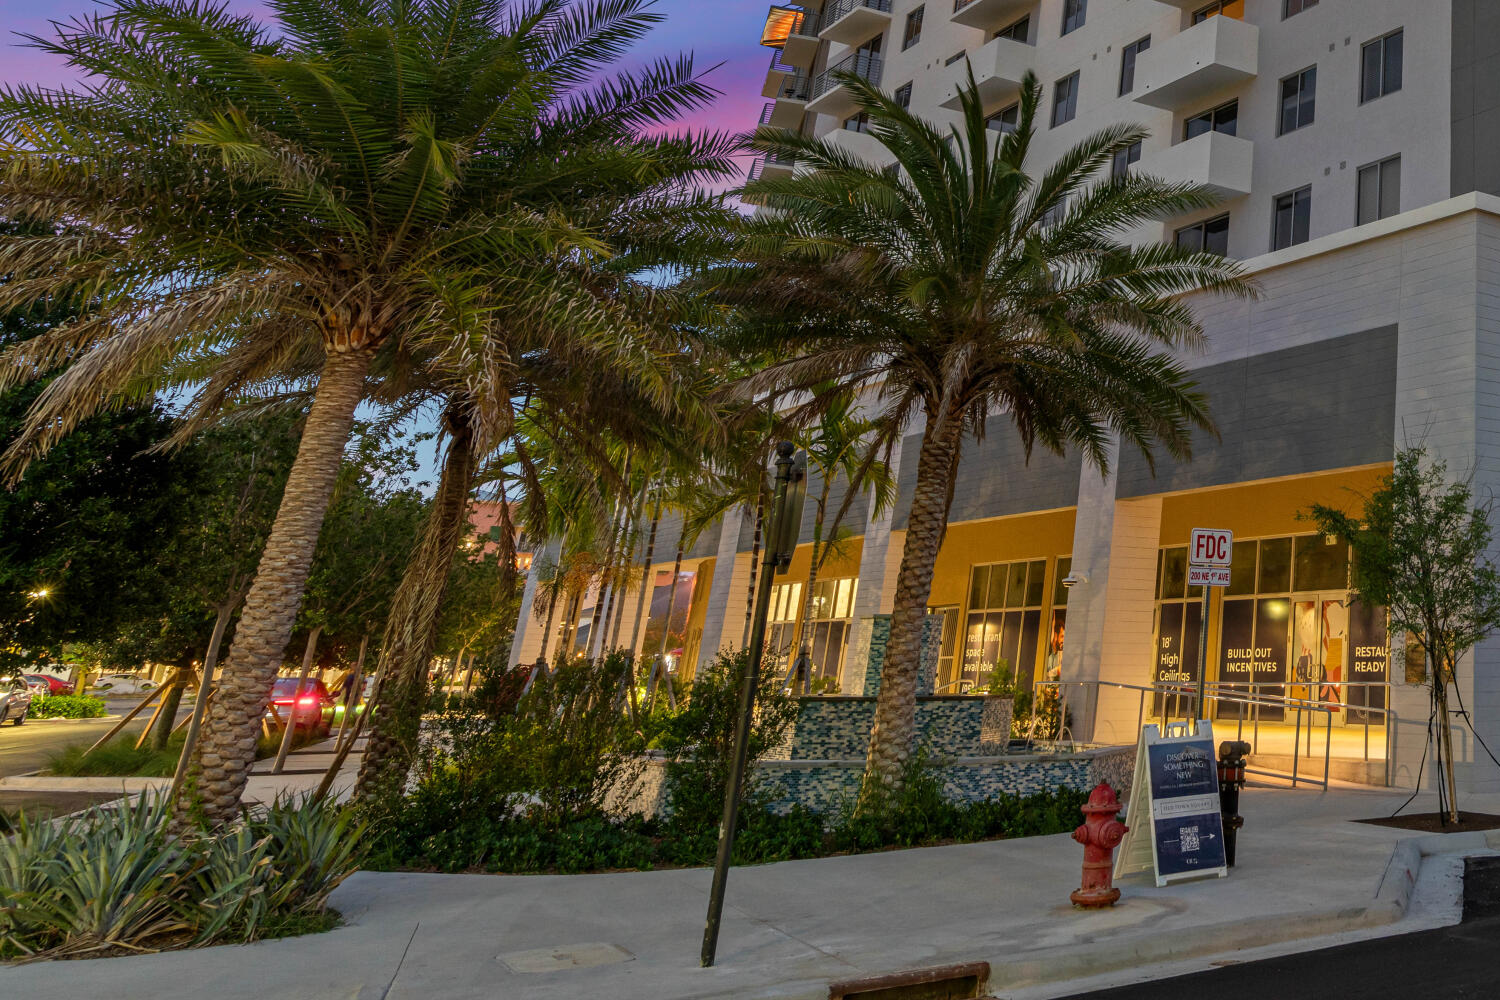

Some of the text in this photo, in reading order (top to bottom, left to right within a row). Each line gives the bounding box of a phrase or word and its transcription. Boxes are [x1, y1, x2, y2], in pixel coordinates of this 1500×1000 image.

[1195, 534, 1227, 560] FDC
[1191, 571, 1201, 580] 200
[1202, 572, 1210, 581] NE
[1218, 573, 1229, 581] AVE
[967, 632, 1001, 642] resturant
[1227, 648, 1272, 659] BUILD OUT
[1161, 653, 1179, 667] High
[1226, 662, 1278, 673] INCENTIVES
[1354, 661, 1386, 673] READY
[1167, 751, 1199, 762] DISCOVER
[1163, 760, 1204, 771] SOMETHING
[1176, 771, 1192, 780] NEW
